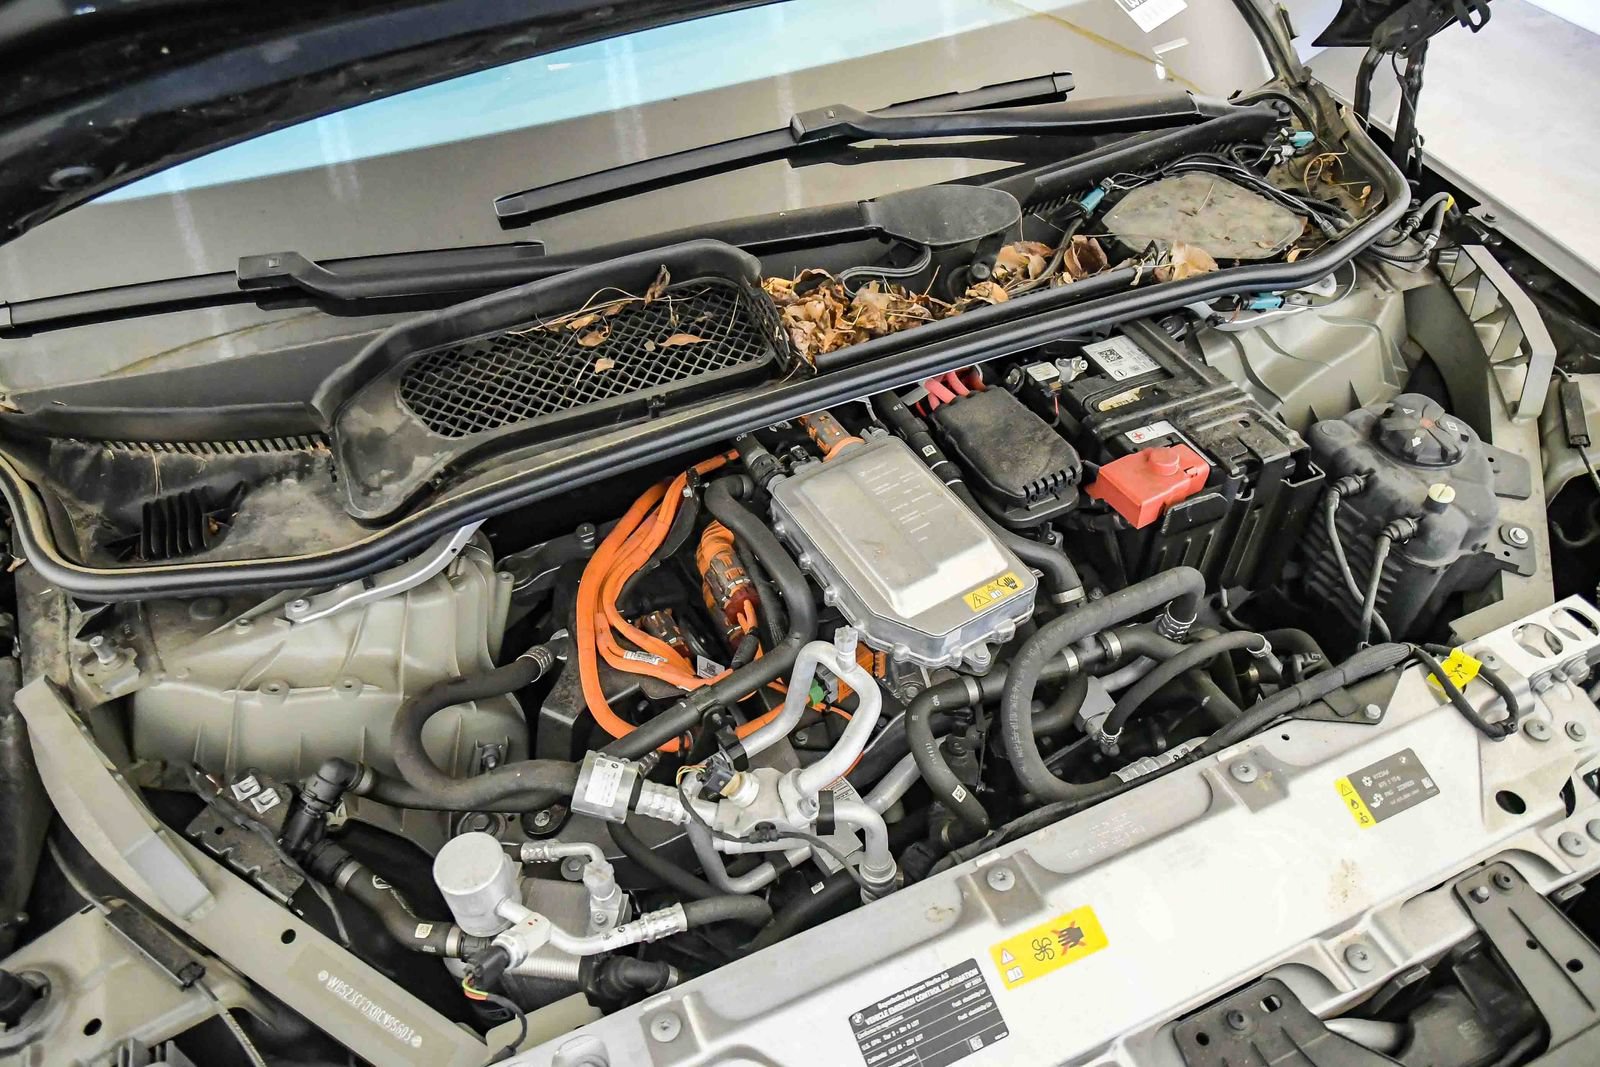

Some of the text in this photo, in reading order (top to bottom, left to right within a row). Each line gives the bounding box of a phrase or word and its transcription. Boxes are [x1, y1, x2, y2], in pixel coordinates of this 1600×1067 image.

[865, 968, 979, 1025] VEHICLE EMISSION CONTROL INFORMATION
